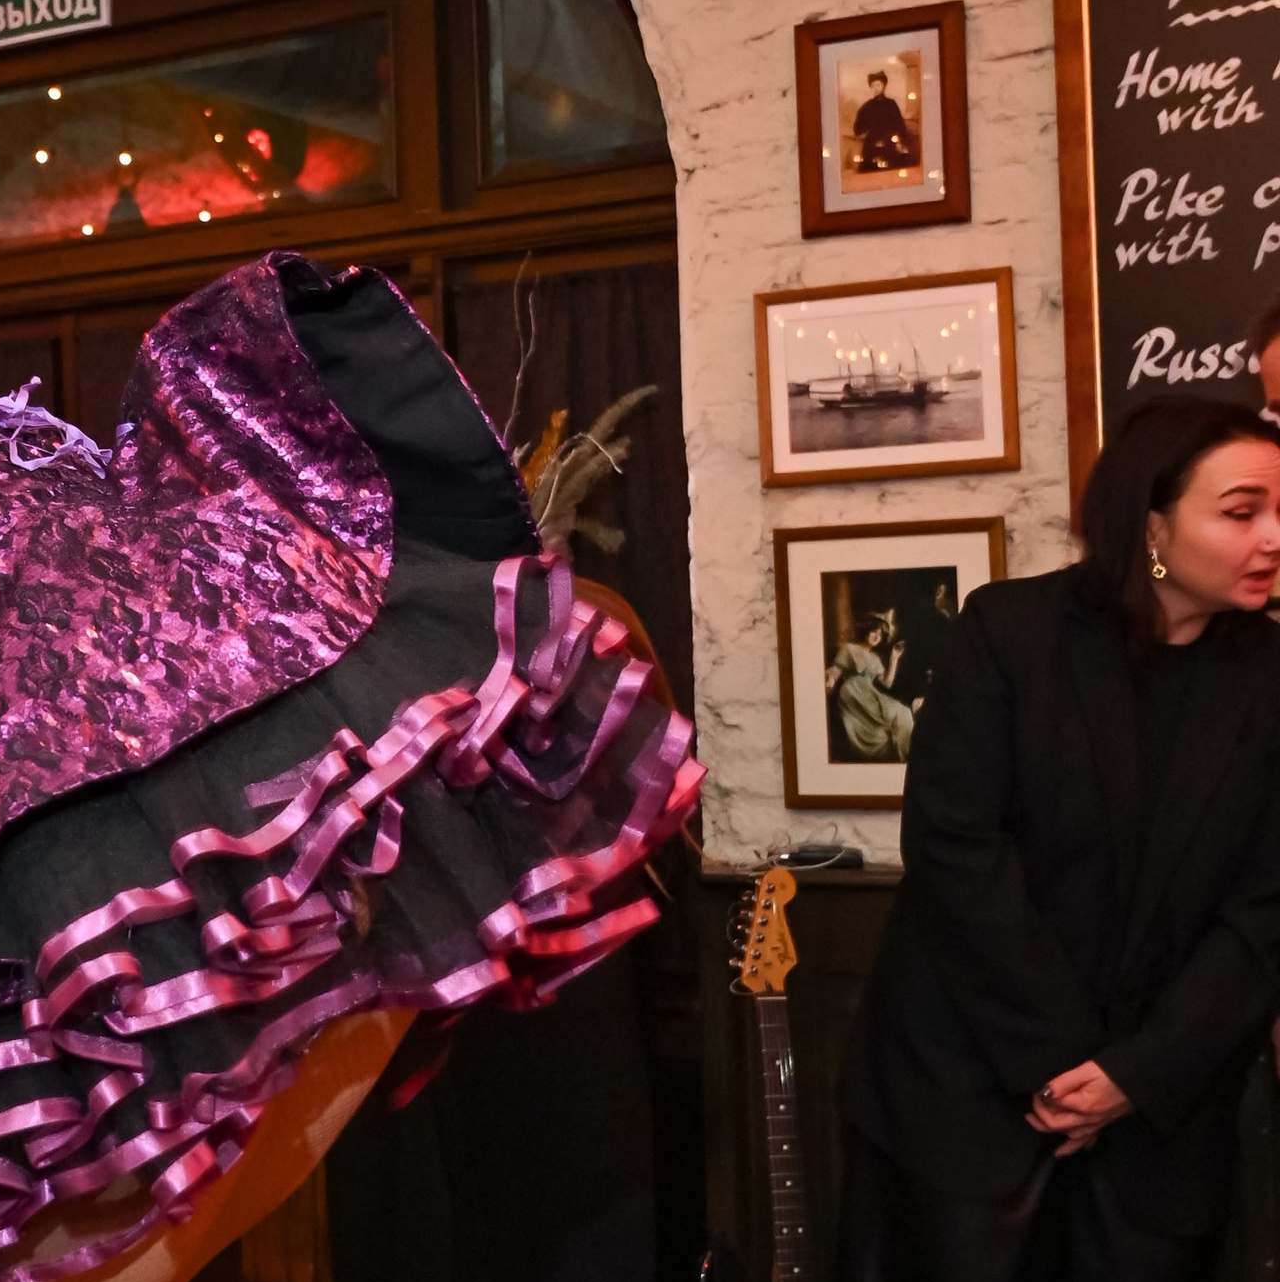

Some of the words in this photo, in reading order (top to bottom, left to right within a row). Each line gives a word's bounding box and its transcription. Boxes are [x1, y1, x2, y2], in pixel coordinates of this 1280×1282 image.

[1114, 47, 1242, 109] Home
[1156, 85, 1264, 135] with
[1114, 167, 1225, 226] Pike
[1114, 221, 1220, 271] with
